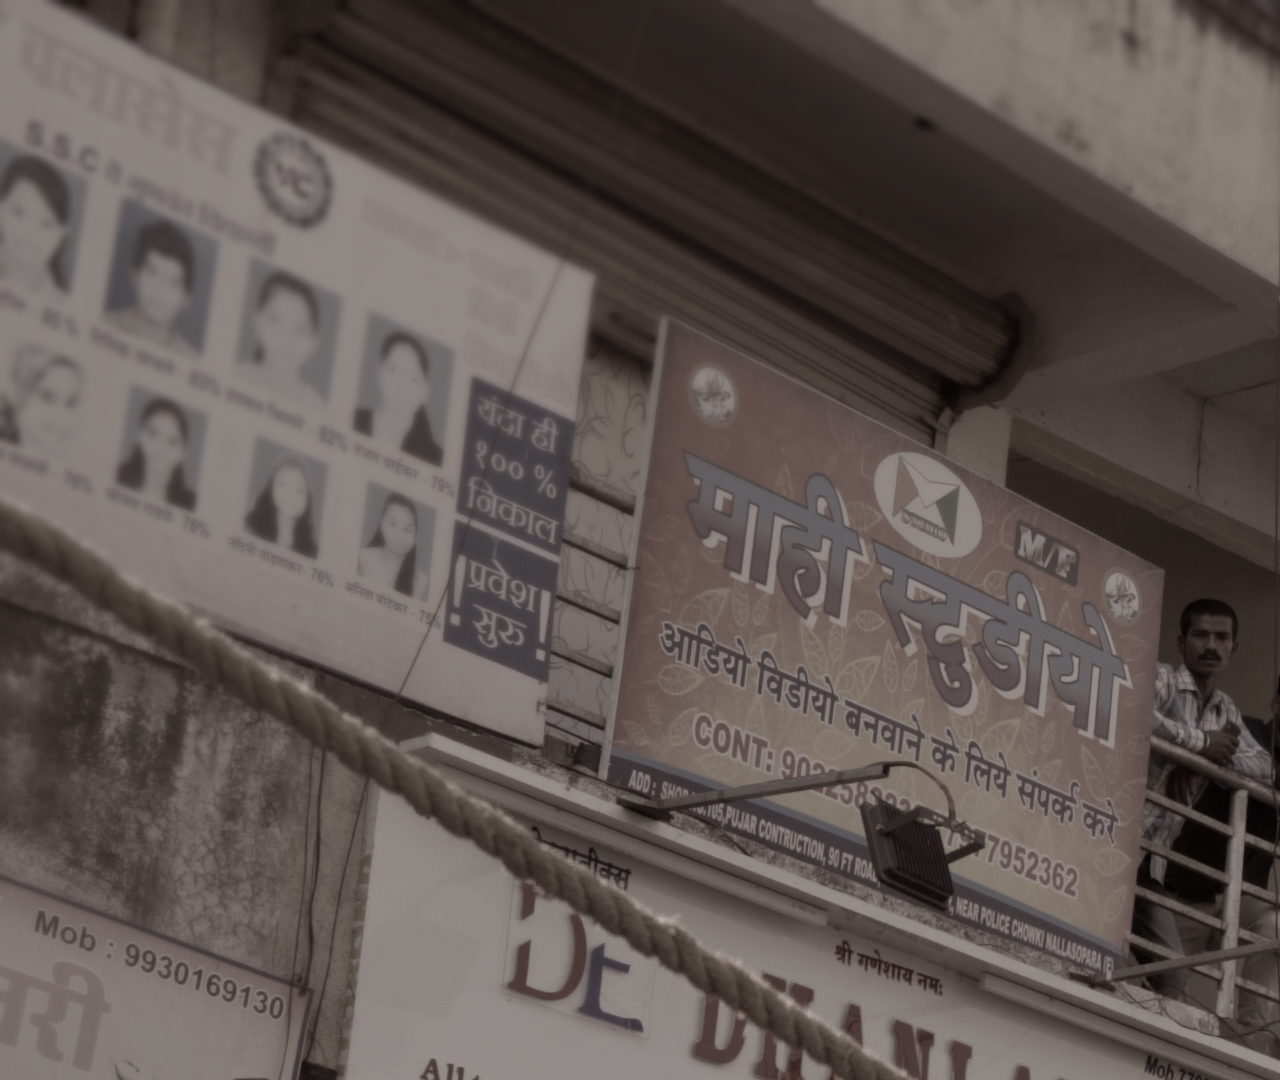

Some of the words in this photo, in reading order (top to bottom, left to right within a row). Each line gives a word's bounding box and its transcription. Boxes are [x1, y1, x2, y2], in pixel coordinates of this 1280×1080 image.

[531, 417, 559, 454] ही
[431, 474, 455, 499] 79%
[467, 477, 560, 544] निकाल
[682, 450, 866, 625] माही
[1018, 525, 1076, 579] M/F
[659, 621, 750, 688] आडियो
[757, 650, 838, 725] विडीयो
[844, 697, 925, 761] बनवाने
[931, 729, 956, 774] के
[965, 740, 1010, 800] लिये
[1017, 767, 1079, 825] संपर्क
[1082, 800, 1119, 845] करे
[694, 714, 774, 773] CONT:
[628, 769, 651, 793] ADD
[828, 846, 841, 867] 90
[841, 851, 853, 874] FT
[956, 897, 978, 924] NEAR
[980, 908, 1010, 935] POLICE
[1011, 915, 1044, 947] CHOWKI
[1045, 930, 1101, 971] NALLASOPARA
[33, 910, 97, 953] Mob
[124, 943, 286, 1020] 9930169130
[835, 940, 854, 966] श्री
[857, 949, 914, 986] गणेशाय
[917, 972, 943, 996] नमः
